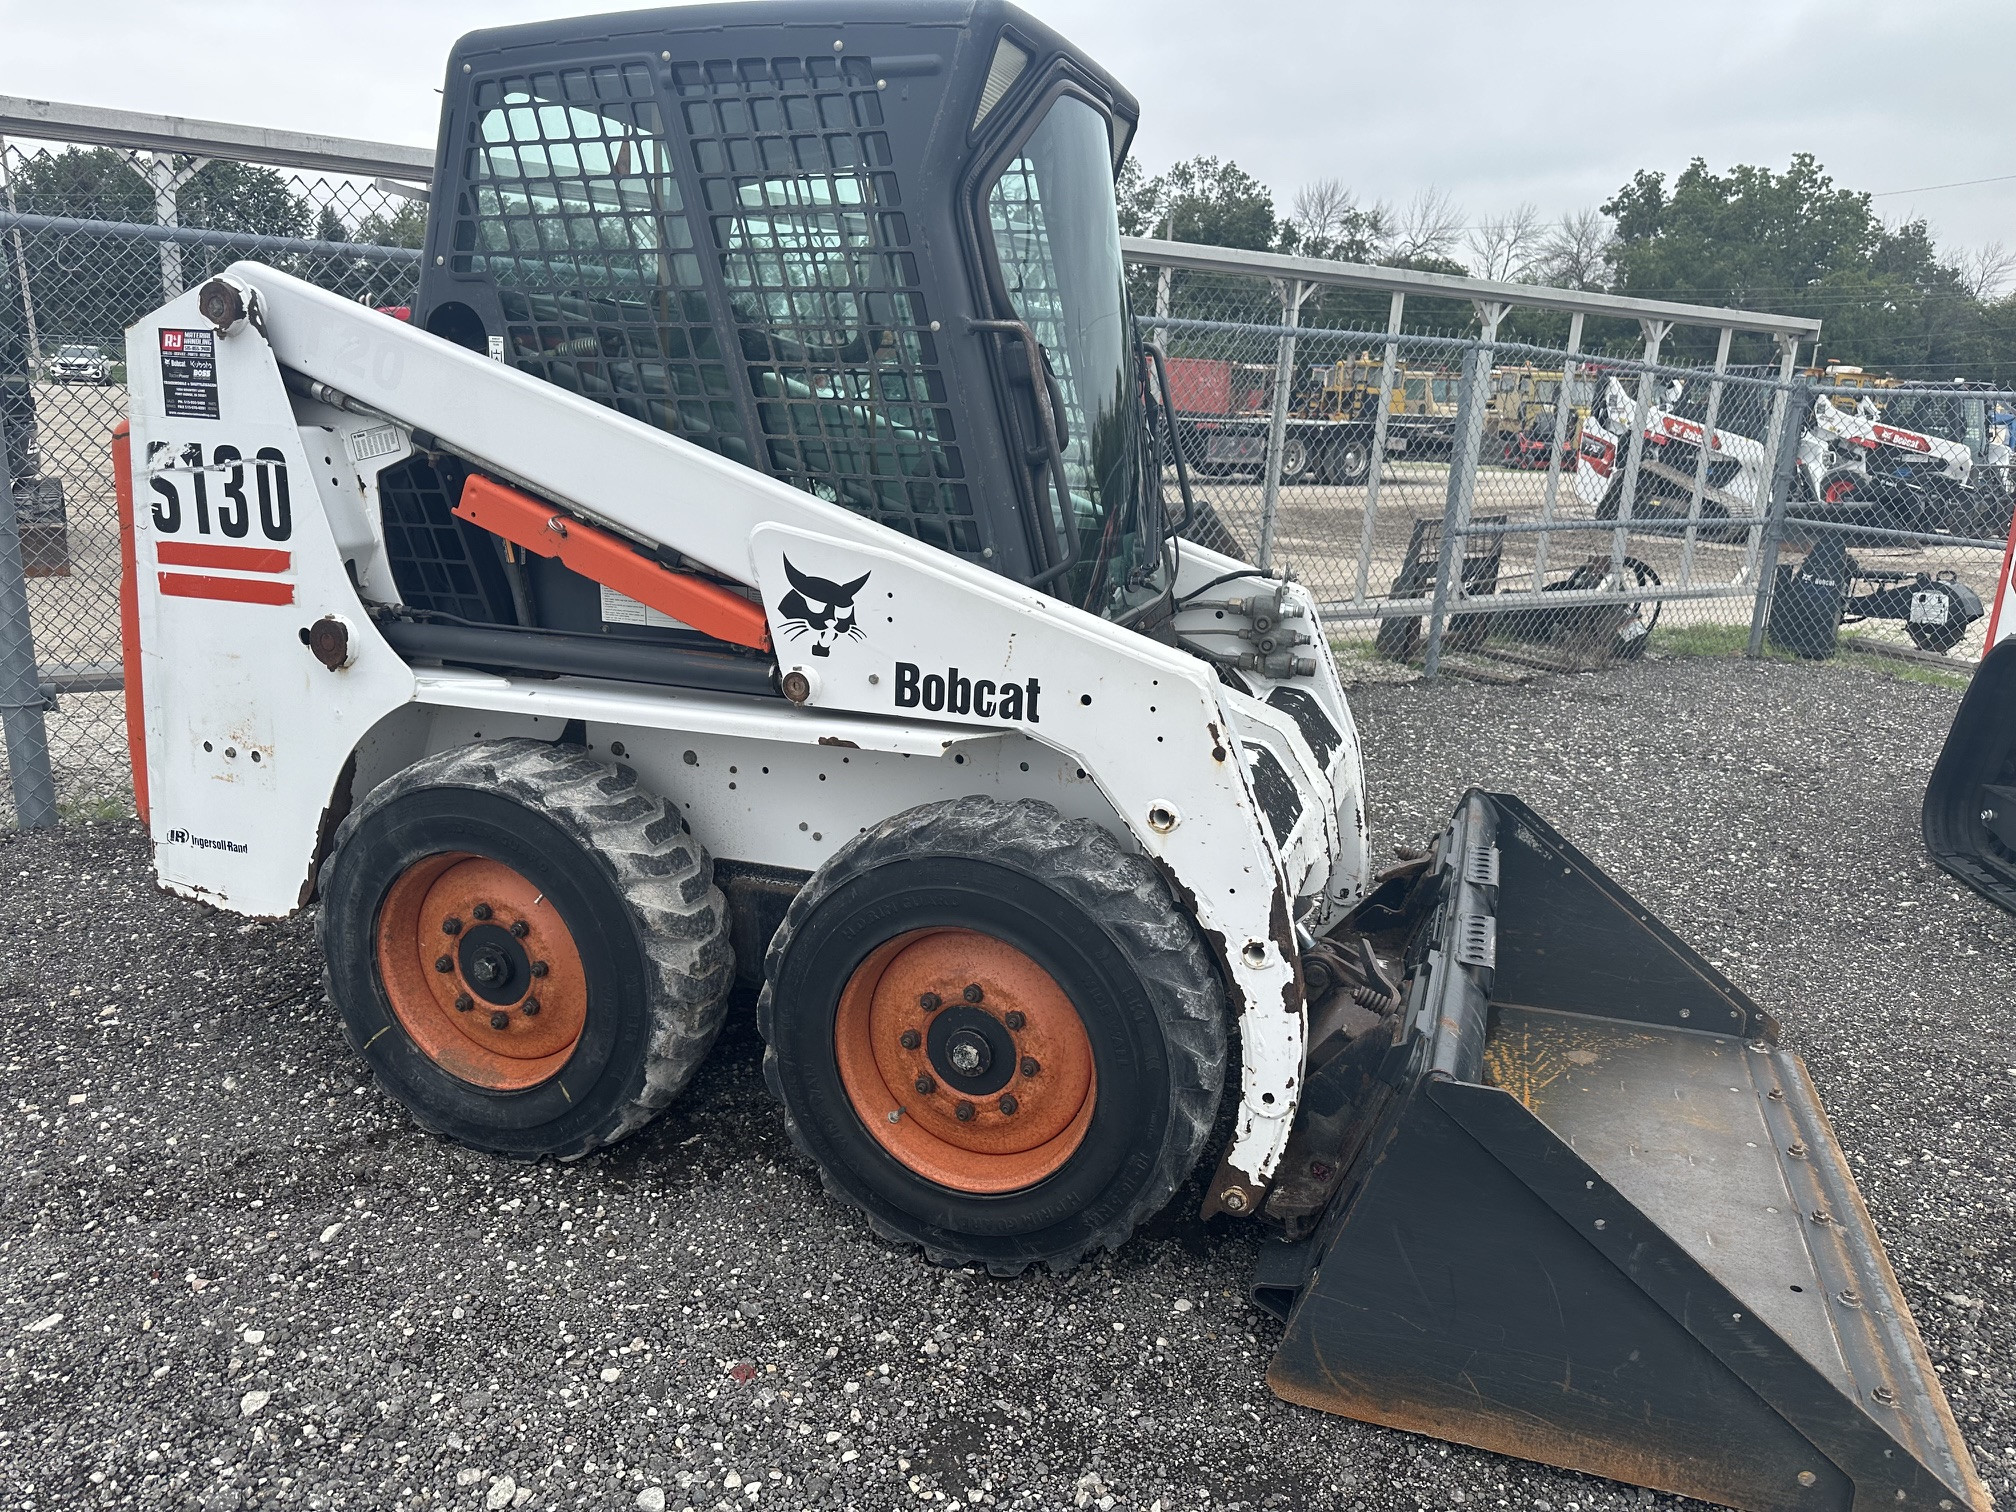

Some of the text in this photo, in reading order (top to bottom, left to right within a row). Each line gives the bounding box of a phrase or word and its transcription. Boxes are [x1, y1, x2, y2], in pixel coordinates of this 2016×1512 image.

[193, 369, 211, 377] BOSS
[1892, 434, 1920, 449] Bobcat
[147, 441, 292, 542] S130
[895, 662, 1041, 723] Bobcat
